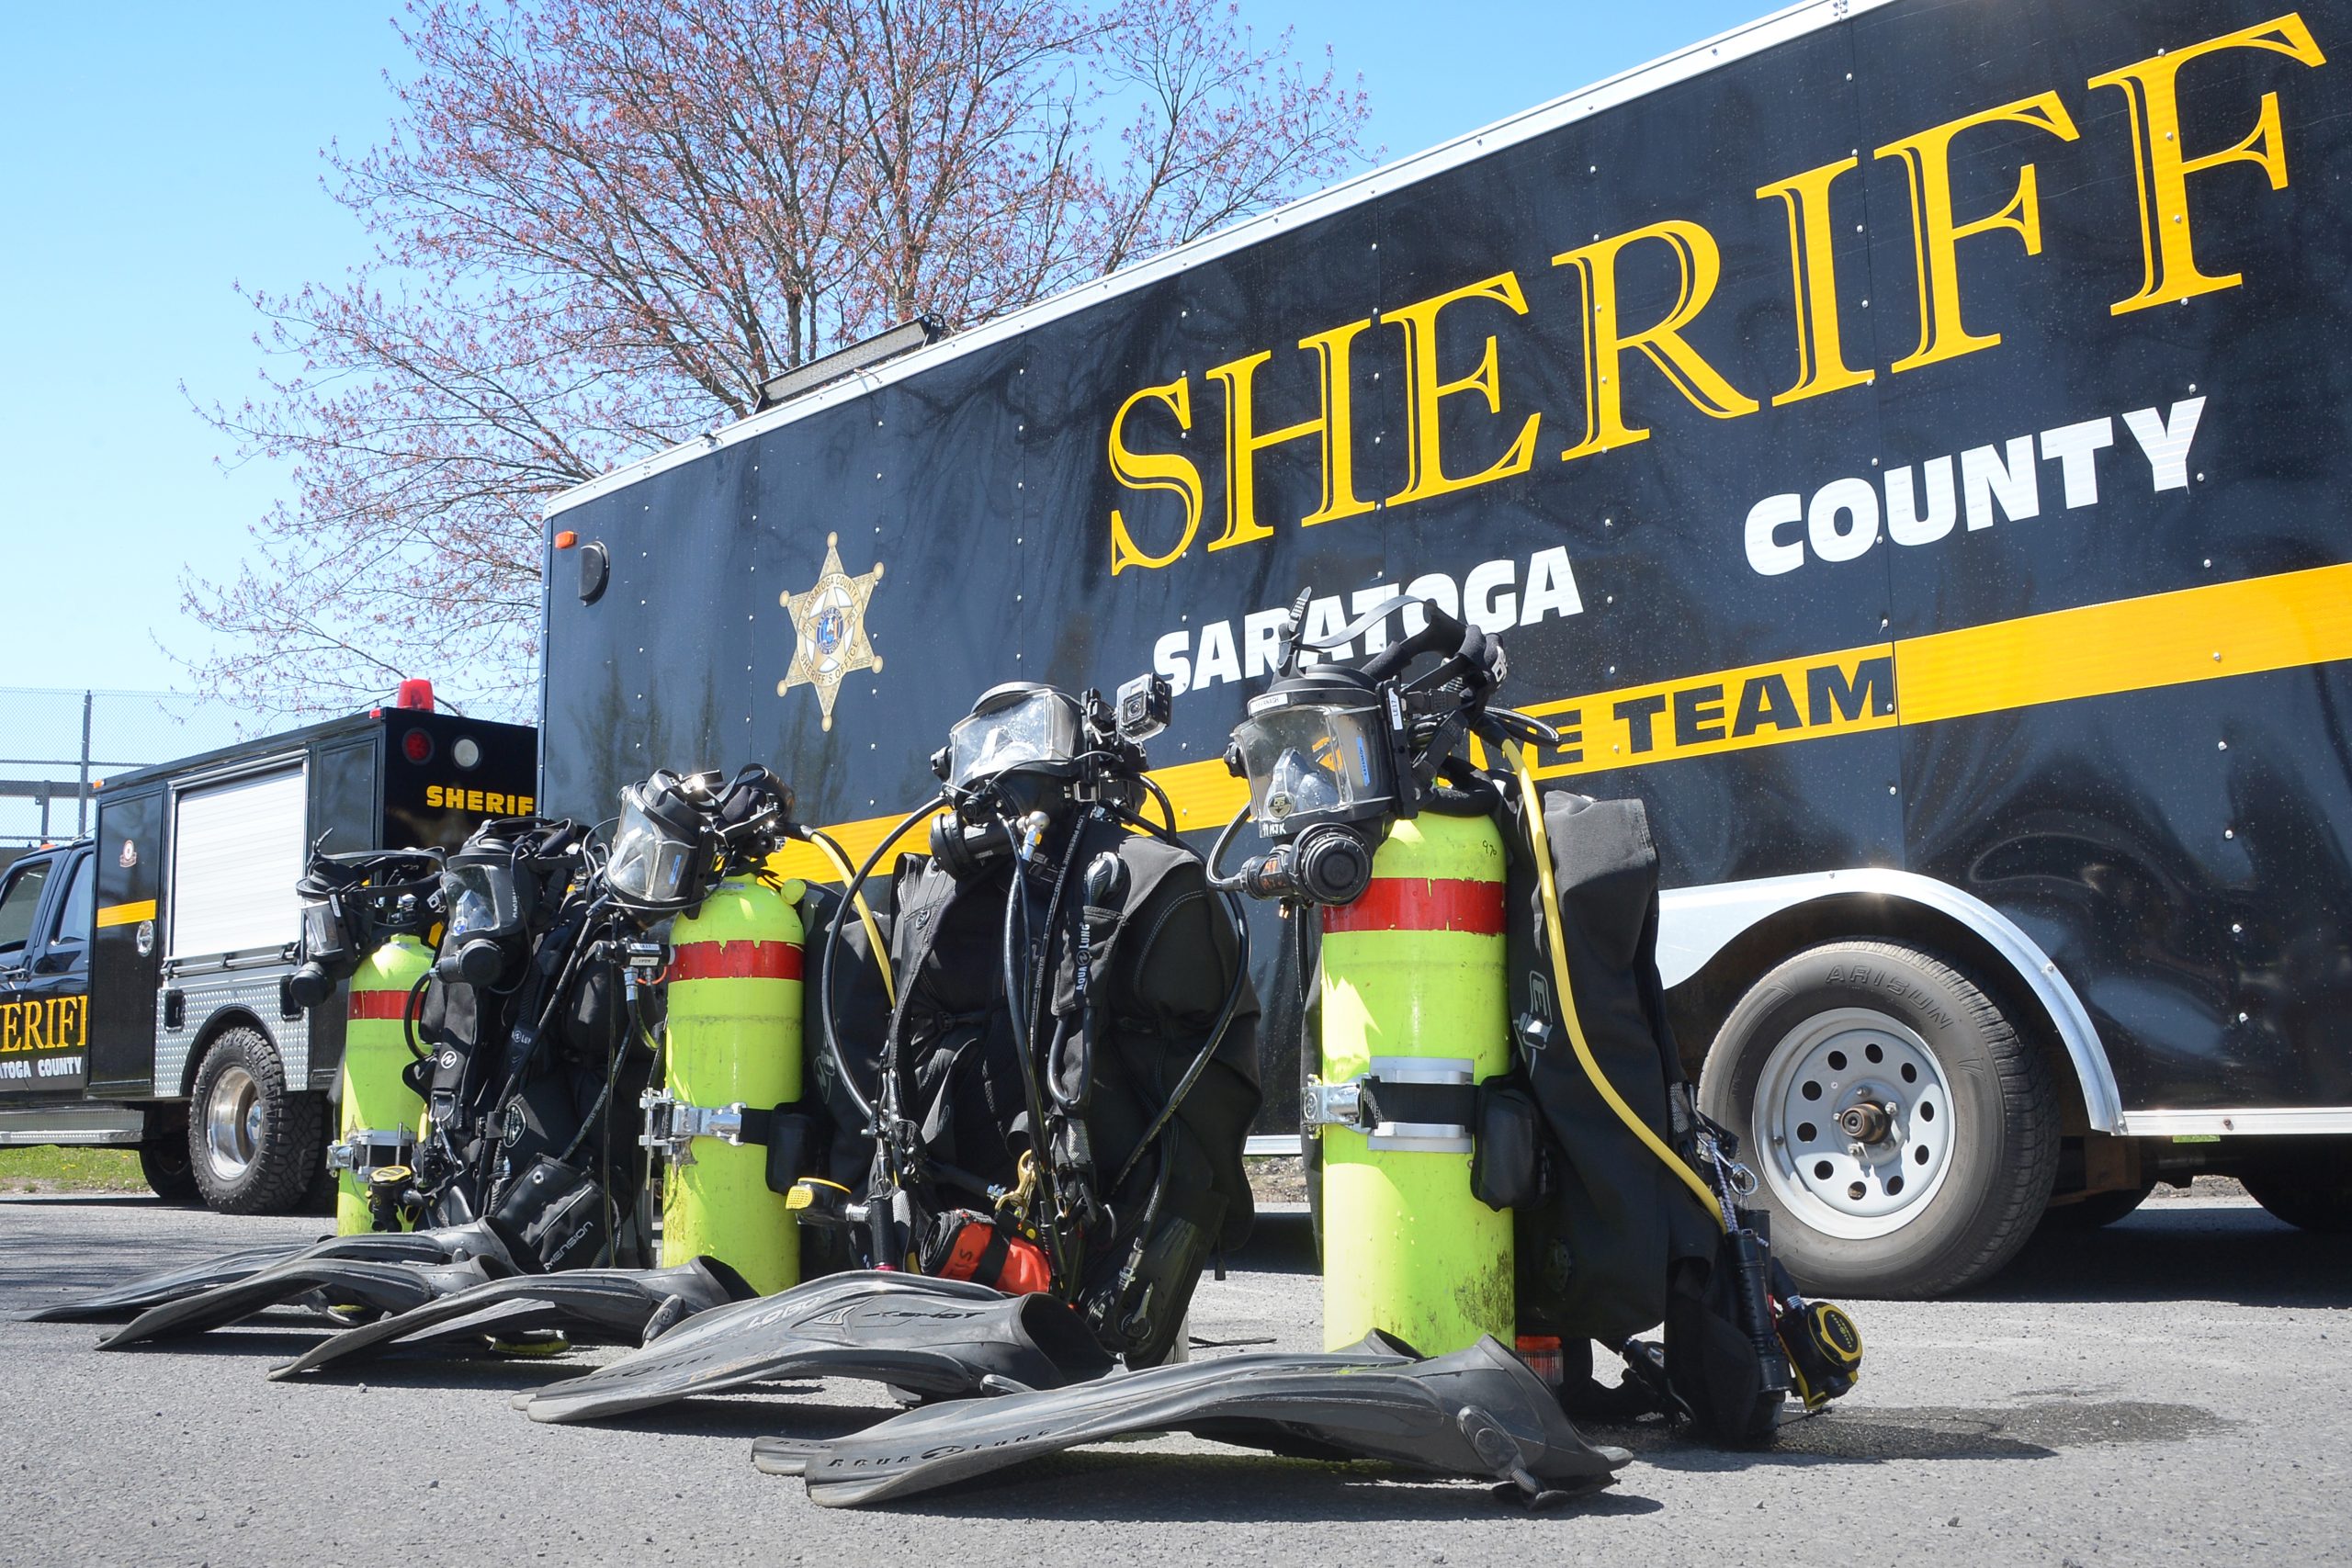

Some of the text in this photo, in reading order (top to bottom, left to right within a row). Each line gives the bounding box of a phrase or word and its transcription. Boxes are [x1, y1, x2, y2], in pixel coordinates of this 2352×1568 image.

[1109, 12, 2327, 573] SHERIFF
[1154, 396, 2207, 697] SARATOGA COUNTY
[804, 575, 858, 613] SARATOGA COUNTY
[800, 640, 859, 683] SHERIFF'S OFFICE
[1612, 656, 1894, 751] TEAM
[426, 784, 534, 817] SHERIF
[1063, 829, 1080, 866] PRESSURE
[1076, 922, 1091, 991] AQUA LUNG
[1825, 964, 1954, 1031] ARISUN
[38, 1056, 83, 1077] COUNTY
[828, 1455, 911, 1467] AQUA
